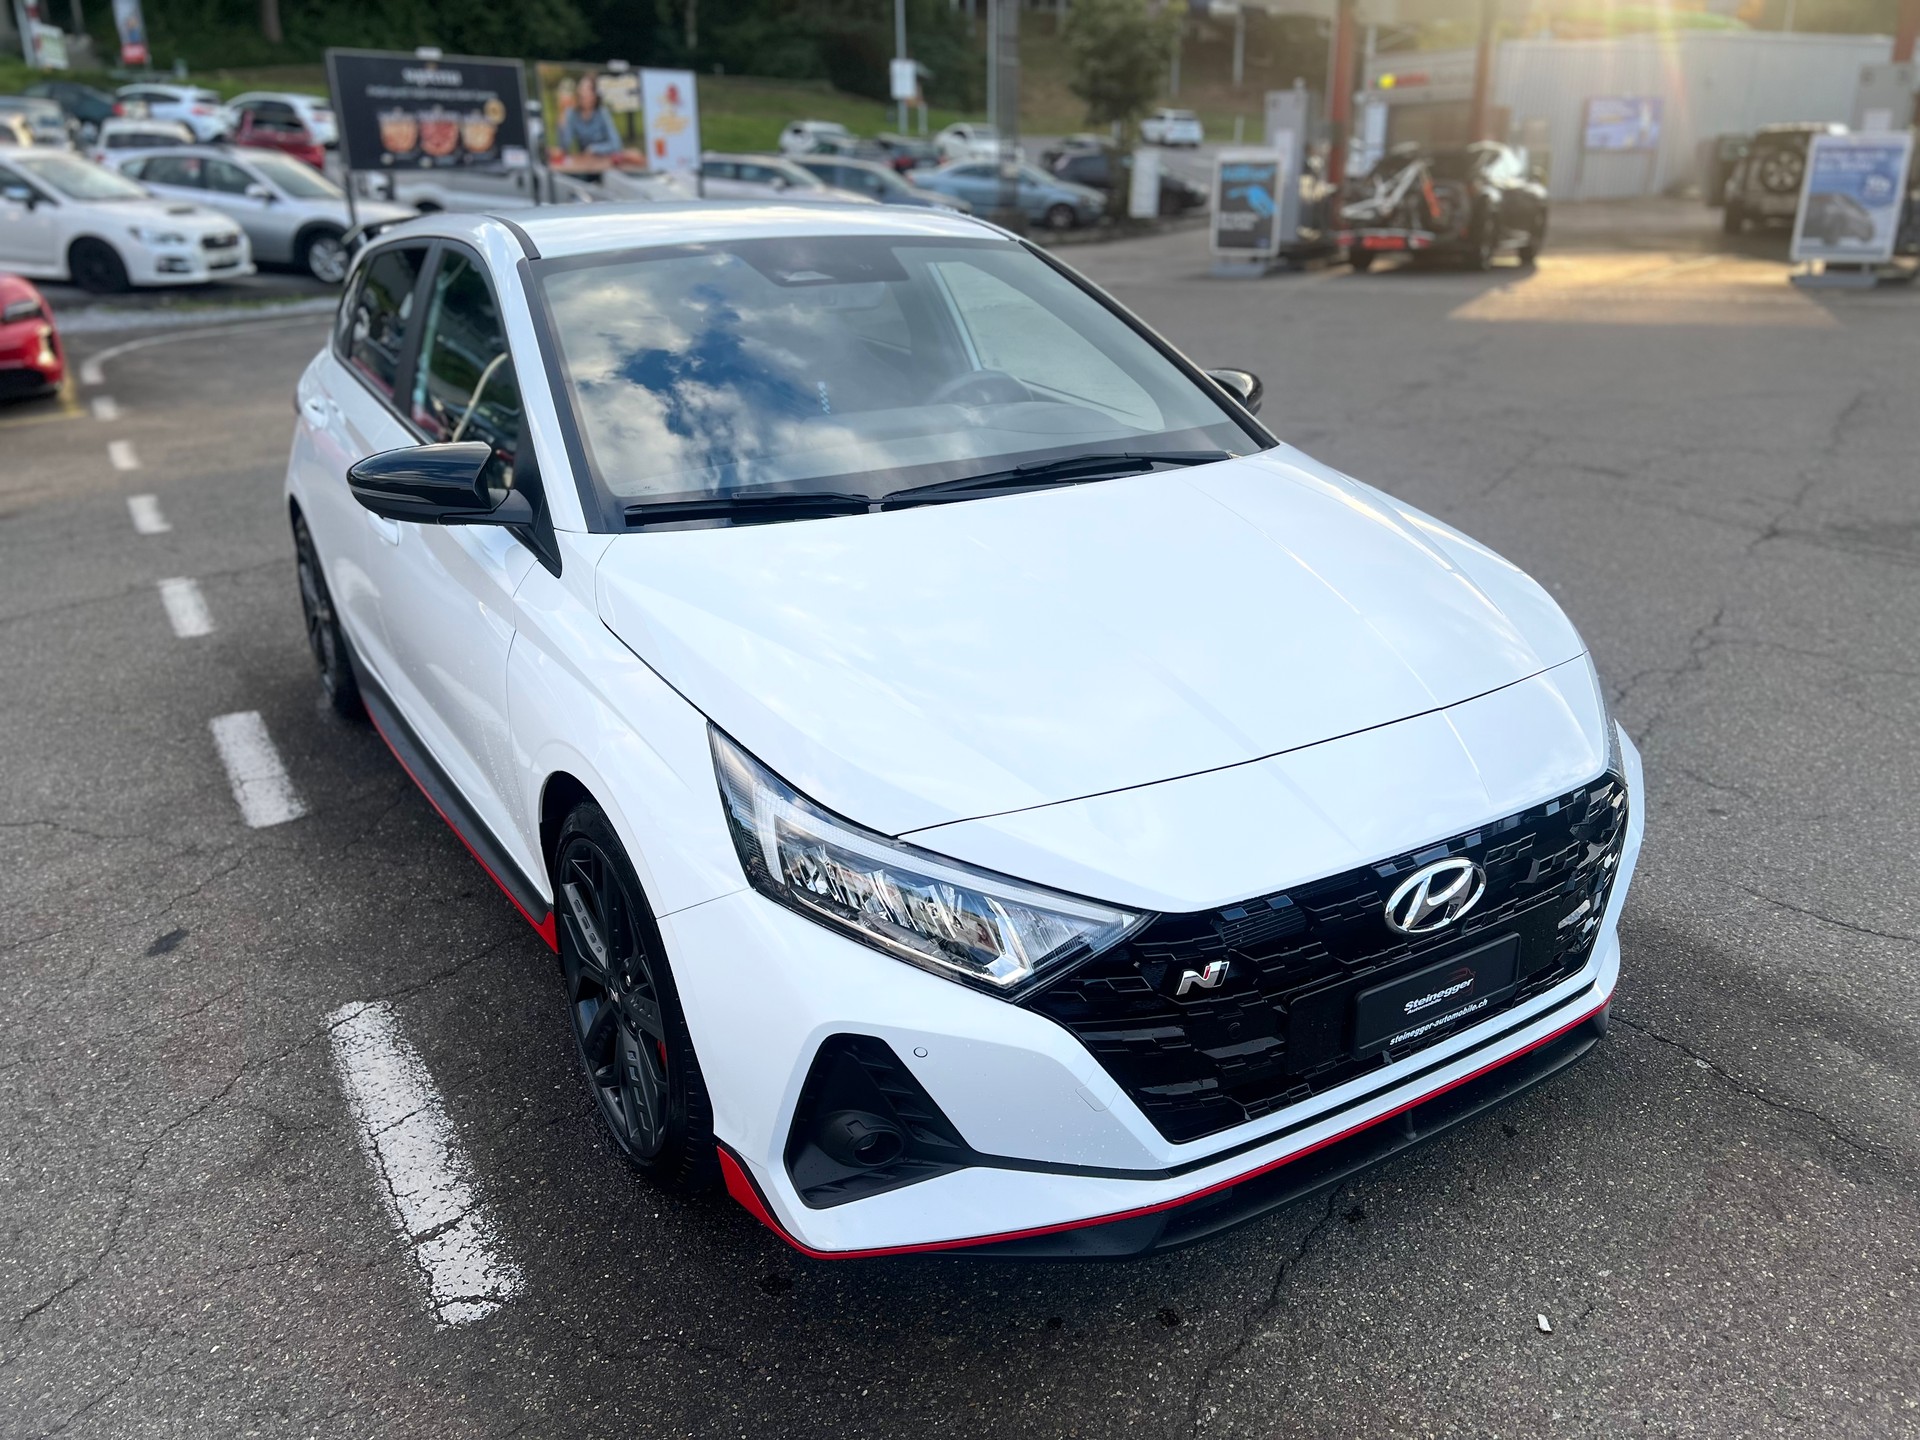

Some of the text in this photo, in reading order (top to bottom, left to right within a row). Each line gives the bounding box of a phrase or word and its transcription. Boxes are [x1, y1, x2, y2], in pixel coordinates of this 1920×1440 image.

[1176, 960, 1230, 996] N
[1403, 977, 1474, 1012] Steinegger
[1389, 998, 1488, 1045] steinegger-automobile.ch
